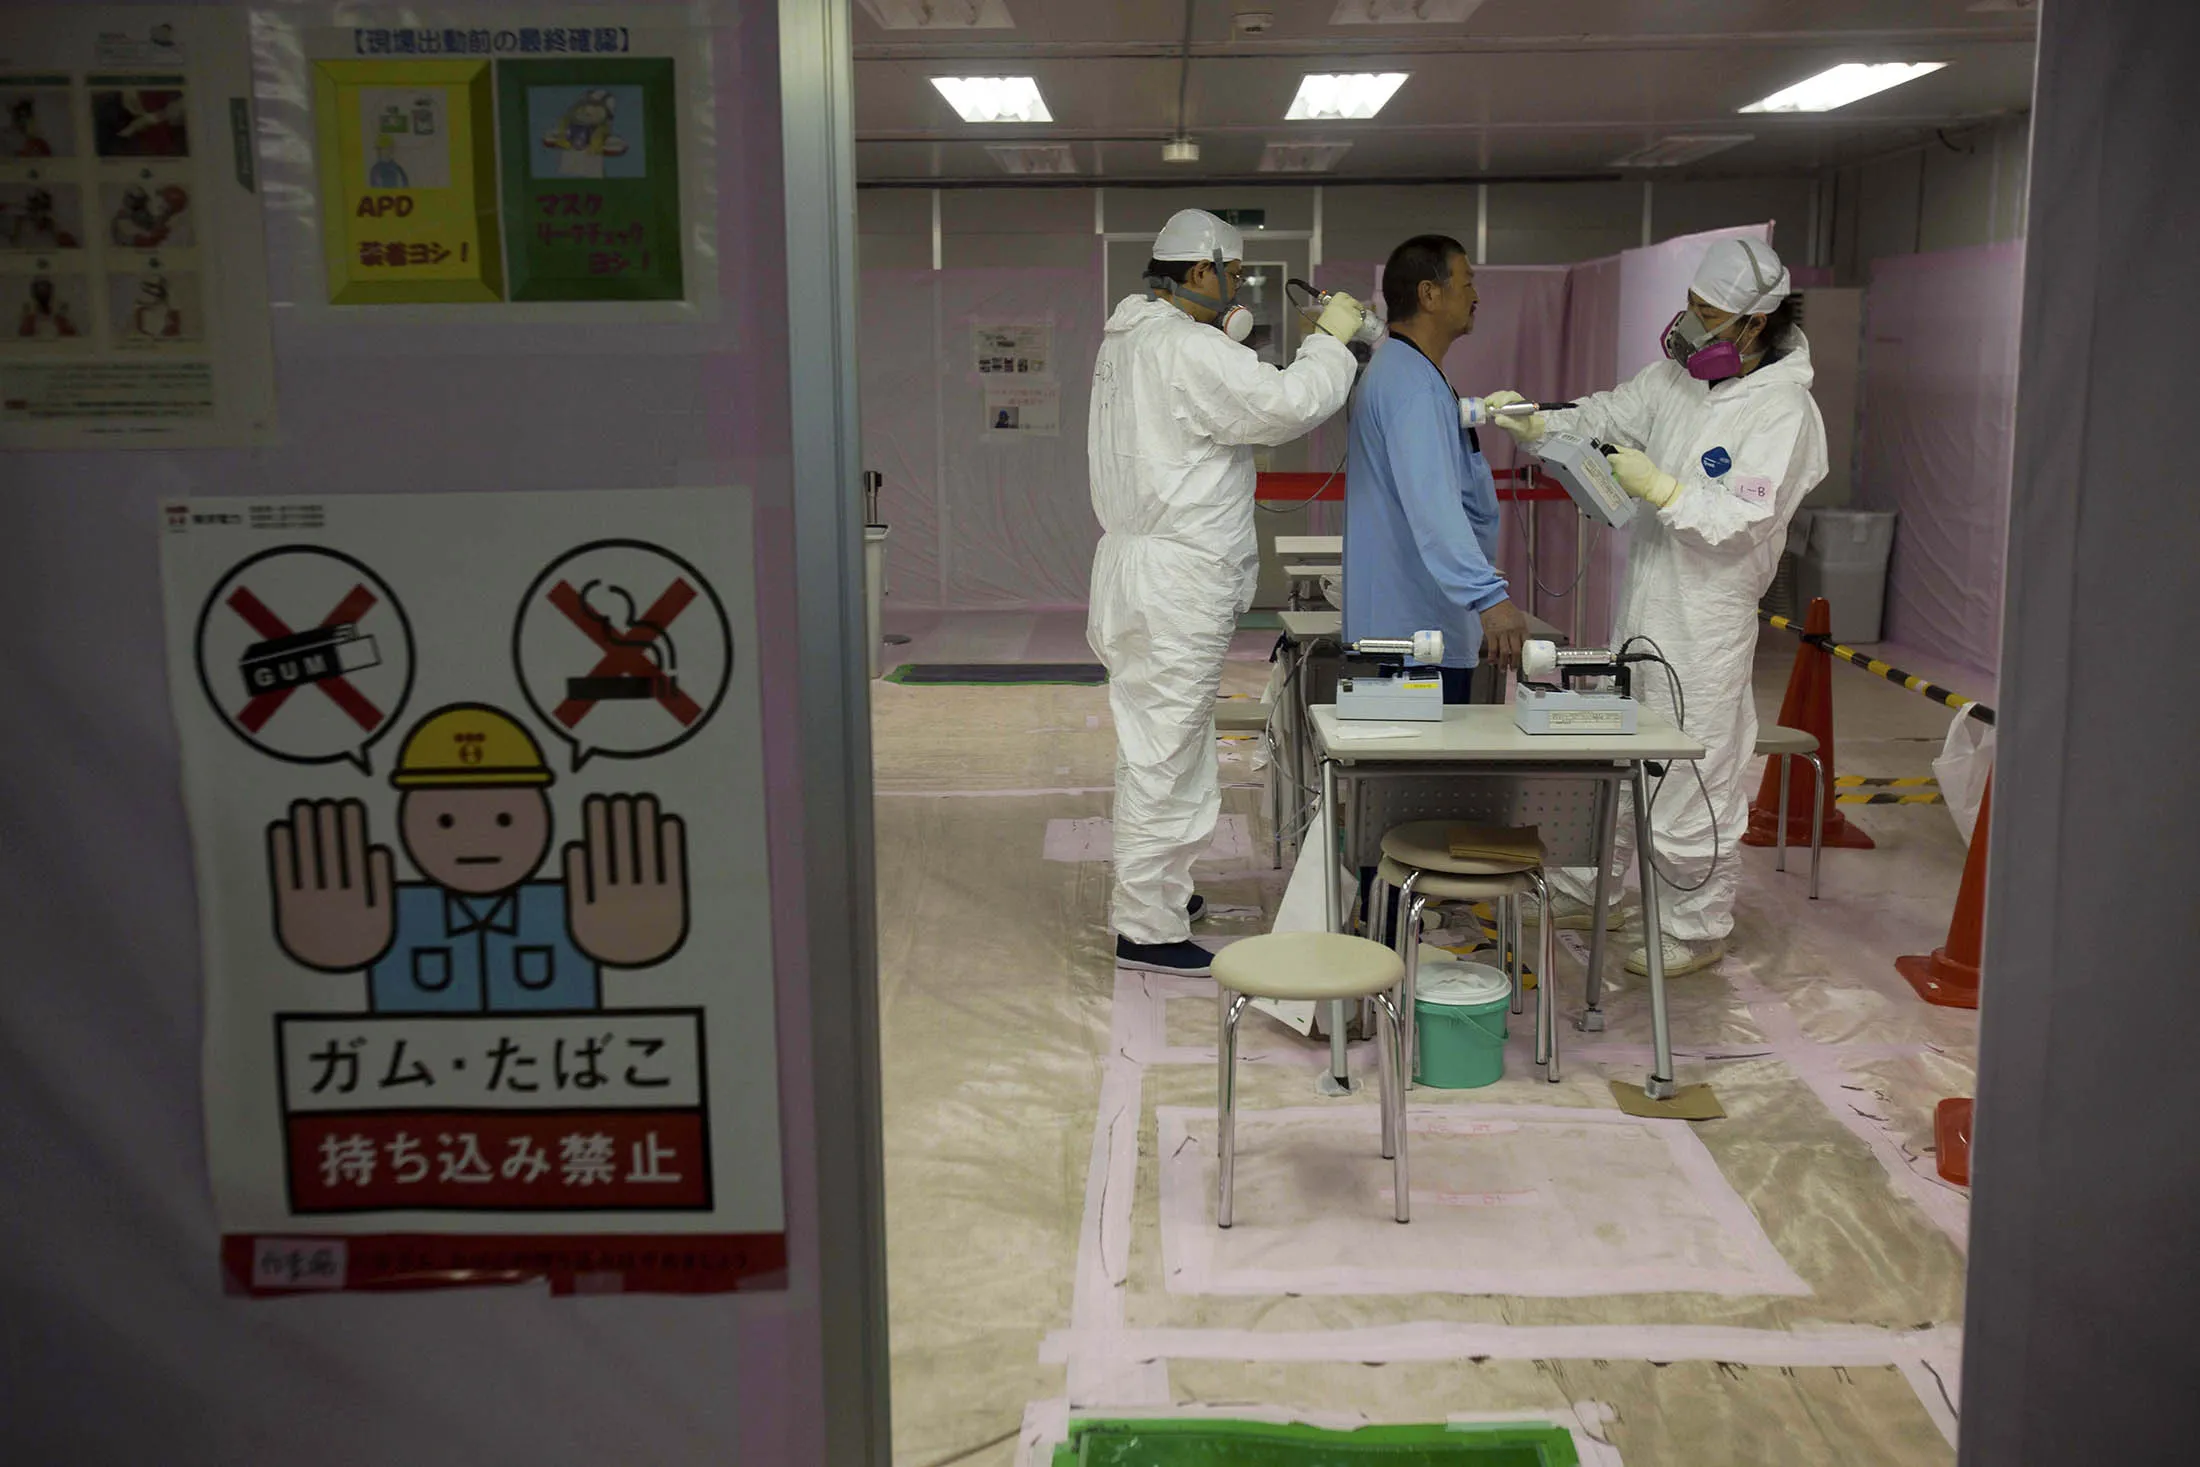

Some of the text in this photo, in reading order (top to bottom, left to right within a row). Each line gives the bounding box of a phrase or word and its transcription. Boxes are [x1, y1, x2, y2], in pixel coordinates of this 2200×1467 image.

[357, 196, 413, 218] APD
[536, 193, 603, 217] マスク
[253, 654, 327, 687] GUM
[309, 1034, 671, 1094] ガム・たばこ
[318, 1131, 684, 1188] 持ち込み禁止
